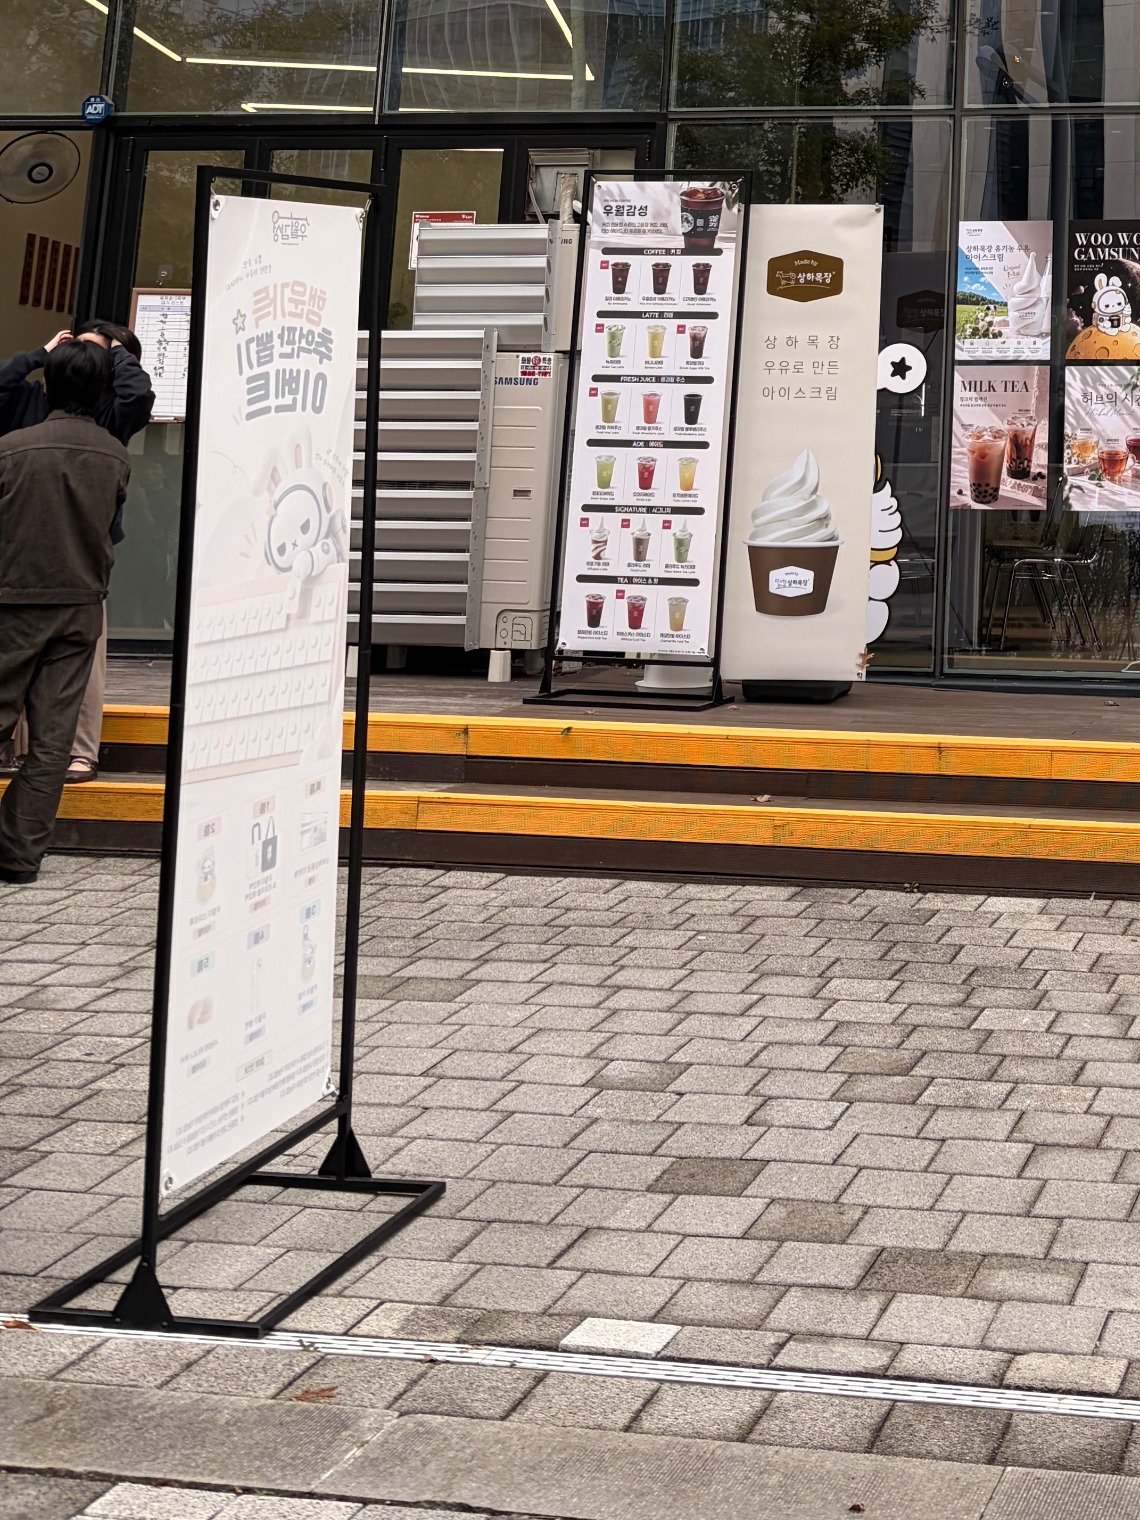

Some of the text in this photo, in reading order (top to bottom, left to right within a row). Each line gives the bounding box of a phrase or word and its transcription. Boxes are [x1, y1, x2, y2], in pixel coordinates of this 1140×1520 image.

[85, 104, 104, 114] ADT
[602, 204, 648, 217] 우월감성
[1075, 233, 1113, 246] WOO
[965, 253, 1004, 262] 아이스크림
[797, 272, 832, 283] 상하목장
[763, 361, 839, 376] 우유로 만든
[960, 381, 1030, 392] MILK TEA
[762, 386, 838, 401] 아이스크림
[1081, 392, 1118, 406] 허브의
